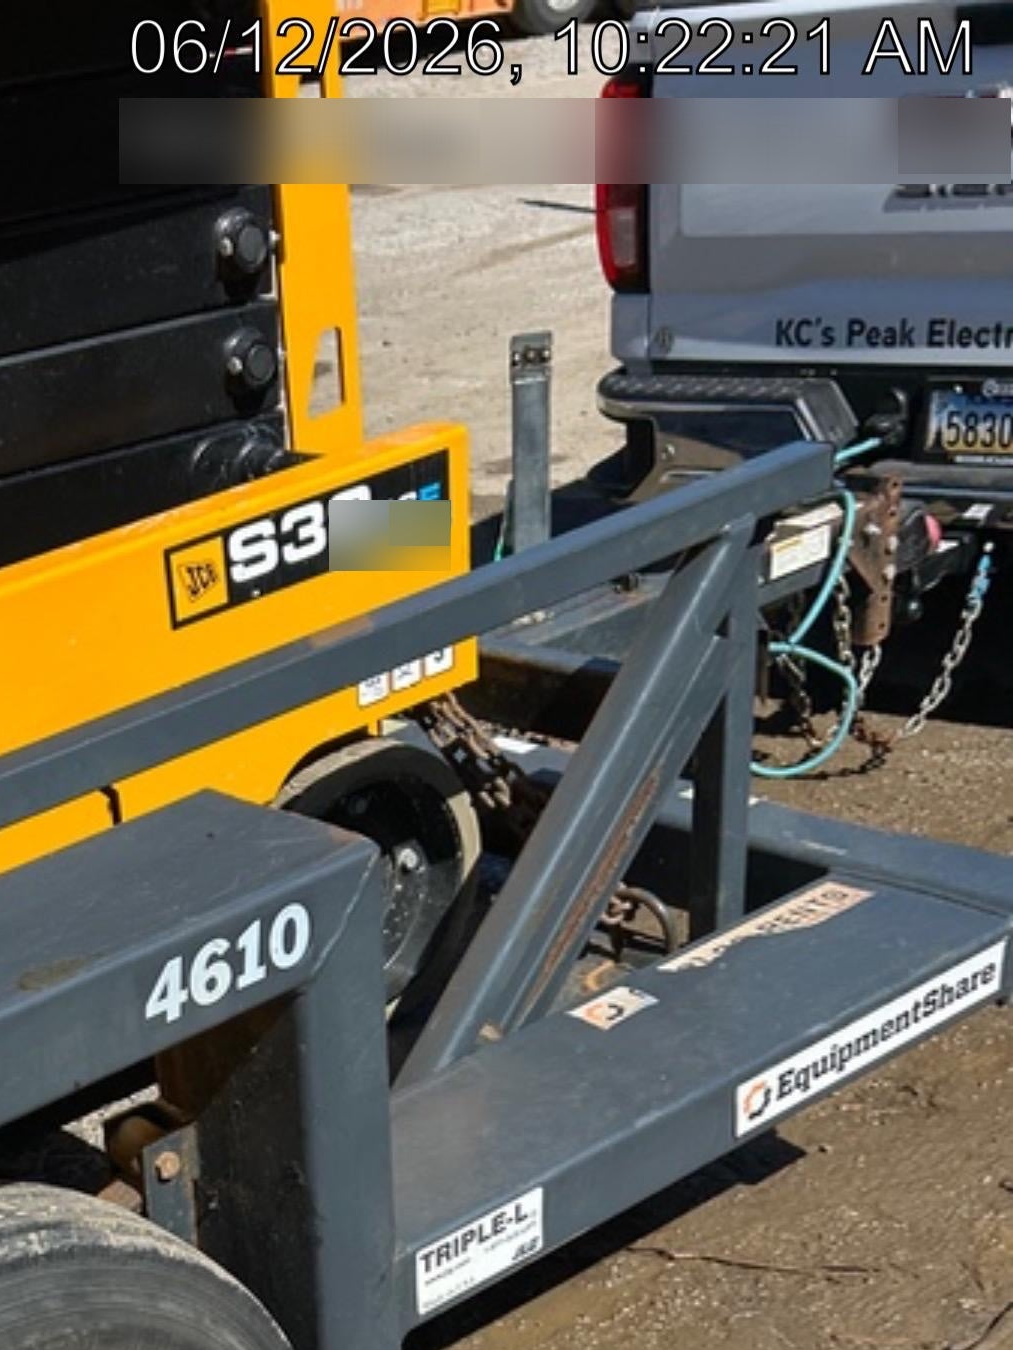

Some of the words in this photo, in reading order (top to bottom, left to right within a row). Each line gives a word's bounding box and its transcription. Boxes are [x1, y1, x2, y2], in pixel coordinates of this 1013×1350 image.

[775, 316, 836, 348] KC's
[846, 317, 916, 349] Peak
[145, 903, 310, 1023] 4610
[776, 962, 996, 1101] EquipmentShare
